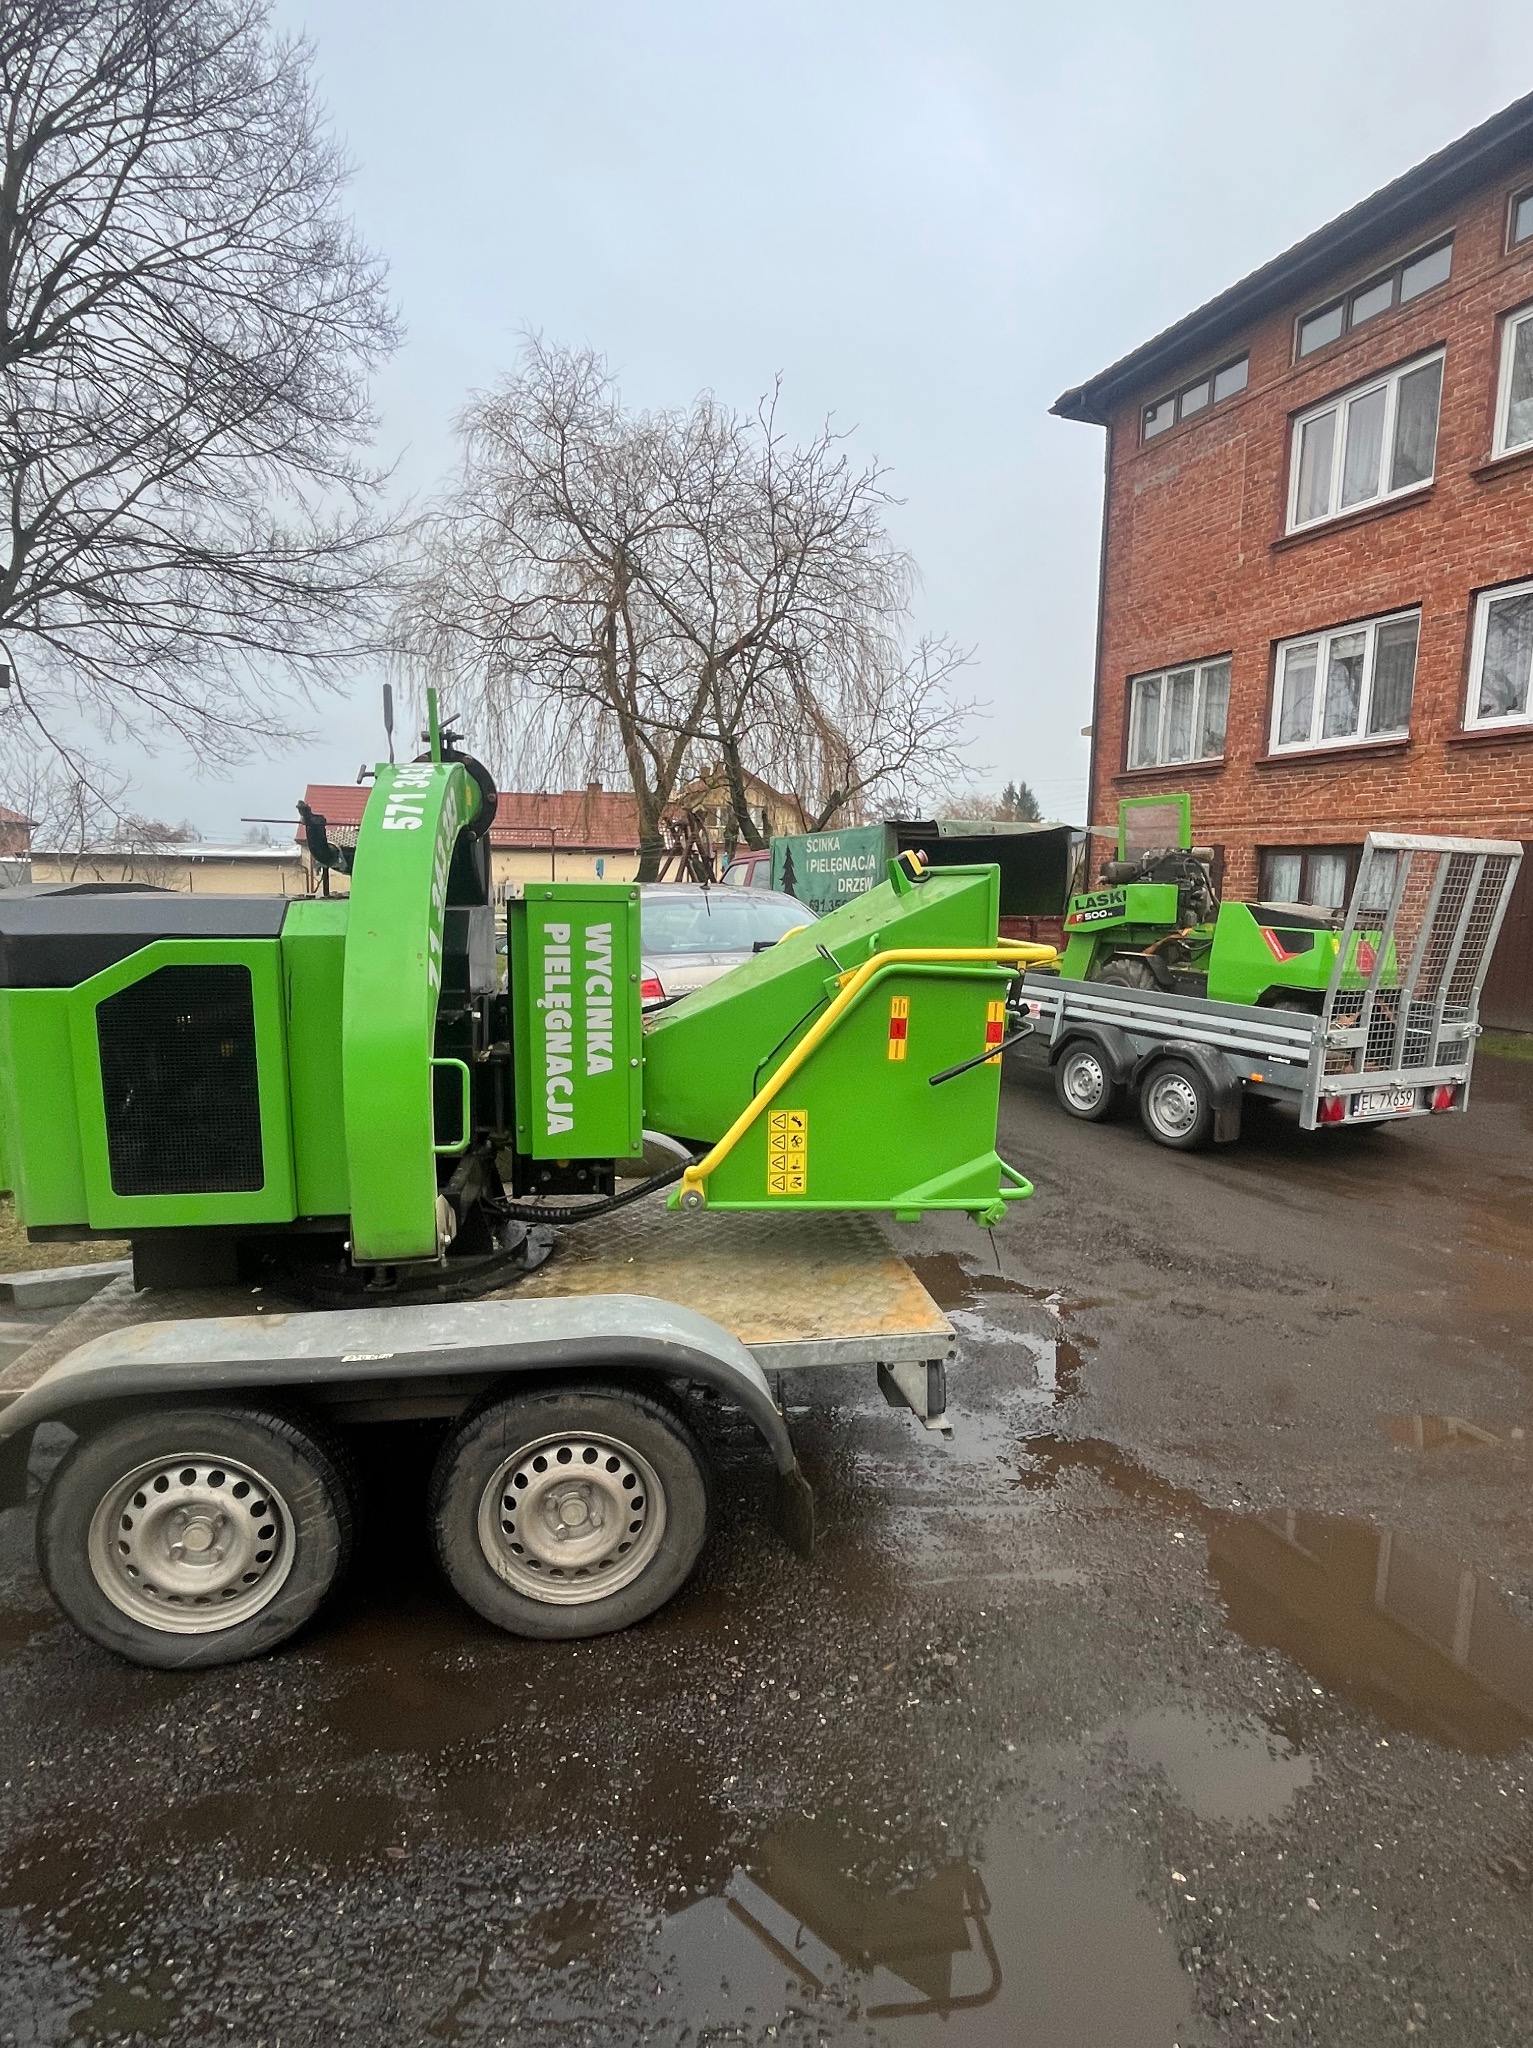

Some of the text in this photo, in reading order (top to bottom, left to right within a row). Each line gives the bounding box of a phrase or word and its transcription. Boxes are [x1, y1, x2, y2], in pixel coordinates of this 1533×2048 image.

[382, 793, 428, 830] 571
[806, 837, 840, 853] ŚCINKA
[810, 854, 876, 875] PIELĘGNACJA
[838, 876, 873, 893] DRZEW
[1075, 890, 1127, 910] LASKI
[585, 922, 613, 1076] WYCINKA
[536, 923, 574, 1136] PIELĘGNACJA
[1361, 1090, 1413, 1110] EL 7X659
